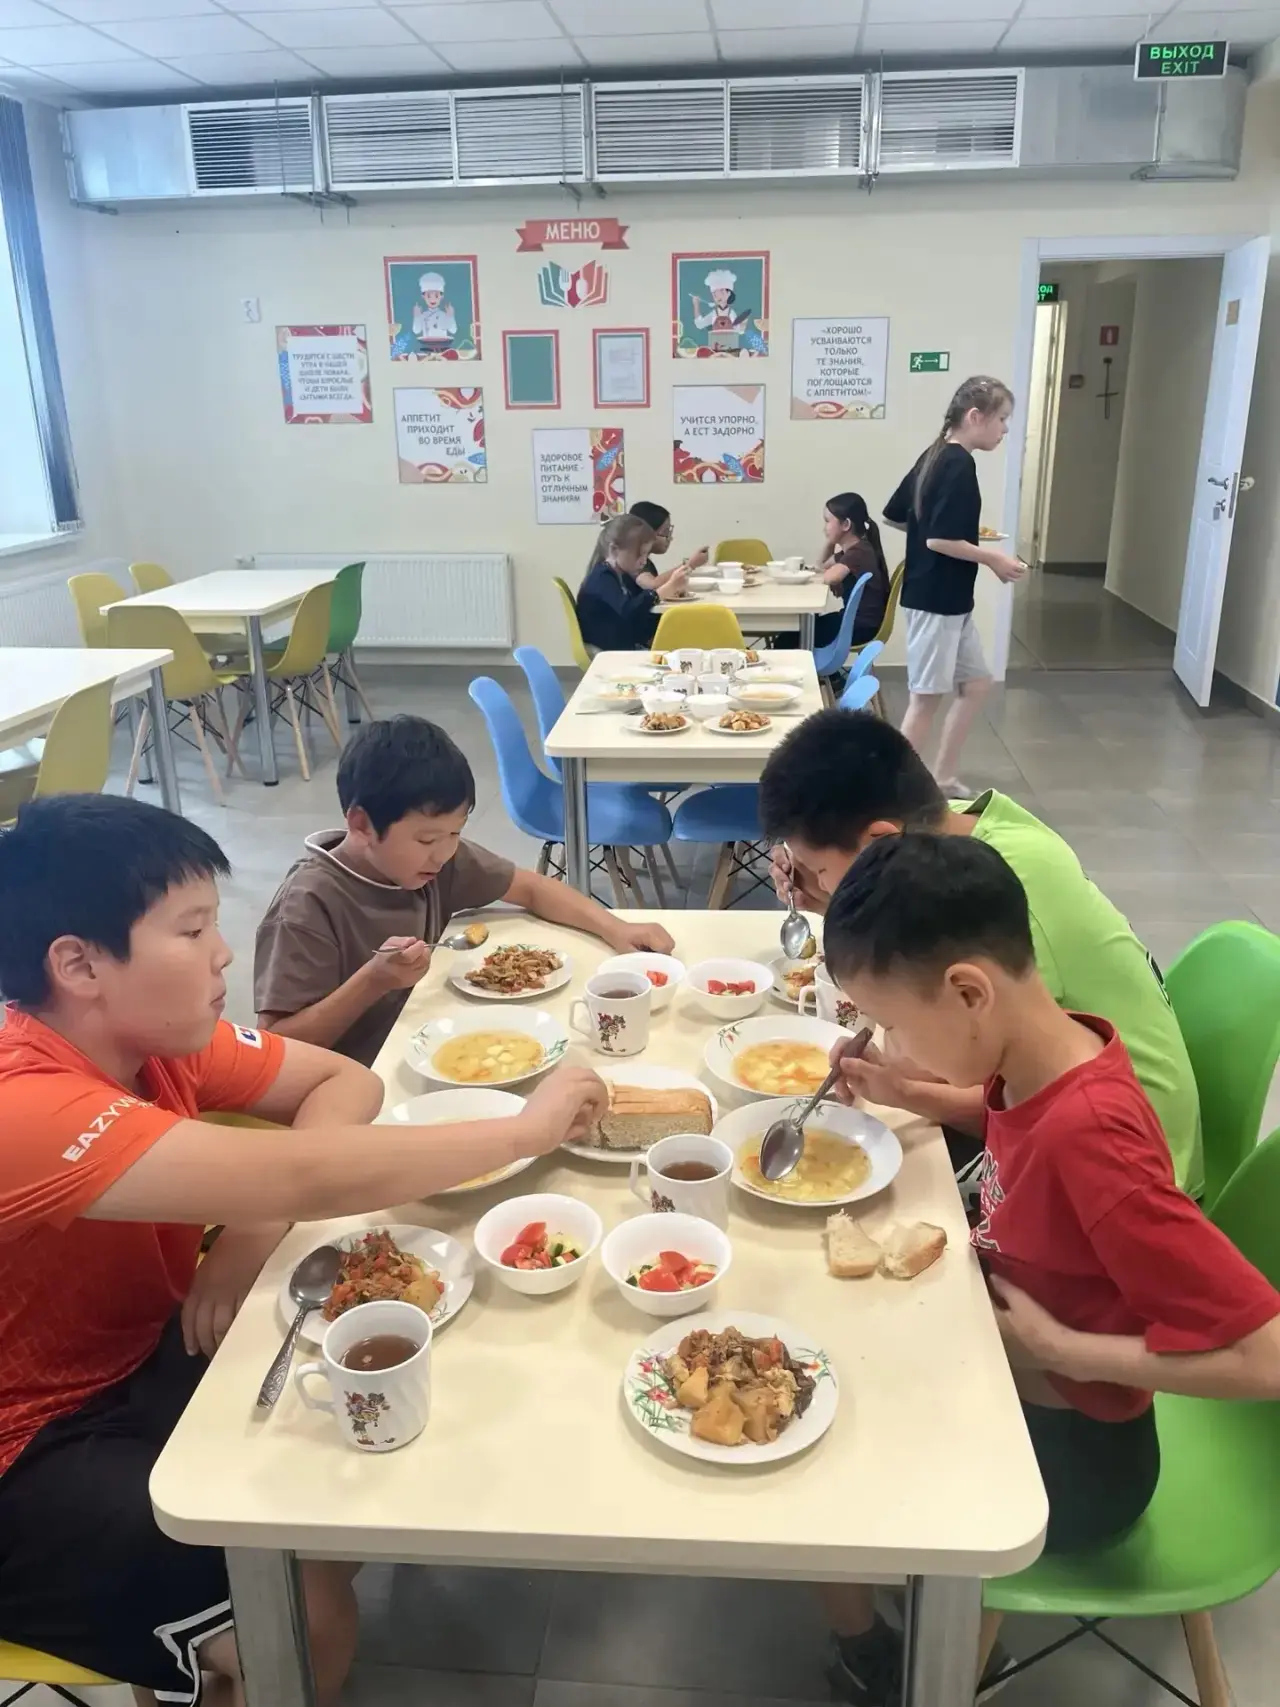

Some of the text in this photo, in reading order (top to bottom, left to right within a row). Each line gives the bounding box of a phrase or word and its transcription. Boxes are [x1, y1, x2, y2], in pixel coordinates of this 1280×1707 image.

[1150, 44, 1214, 60] ВЫХОД
[1161, 61, 1200, 75] EXIT
[545, 221, 600, 240] МЕНЮ
[810, 336, 872, 346] УСВАИВАЮТСЯ
[824, 347, 858, 356] ТОЛЬКО
[816, 357, 826, 366] ТЕ
[820, 368, 860, 376] КОТОРЫЕ
[807, 378, 873, 387] ПОГЛОЩАЮТСЯ
[806, 388, 812, 397] С
[401, 413, 441, 423] АППЕТИТ
[680, 416, 716, 425] УЧИТСЯ
[407, 425, 455, 434] ПРИХОДИТ
[684, 426, 755, 437] А ЕСТ ЗАДОРНО
[418, 436, 462, 445] ВО ВРЕМЯ
[446, 446, 466, 457] ЕДЫ
[540, 453, 584, 463] ЗДОРОВОЕ
[540, 464, 579, 472] ПИТАНИЕ
[541, 474, 570, 483] ПУТЬ К
[541, 484, 589, 493] ОТЛИЧНЫМ
[541, 494, 581, 503] ЗНАНИЯМ
